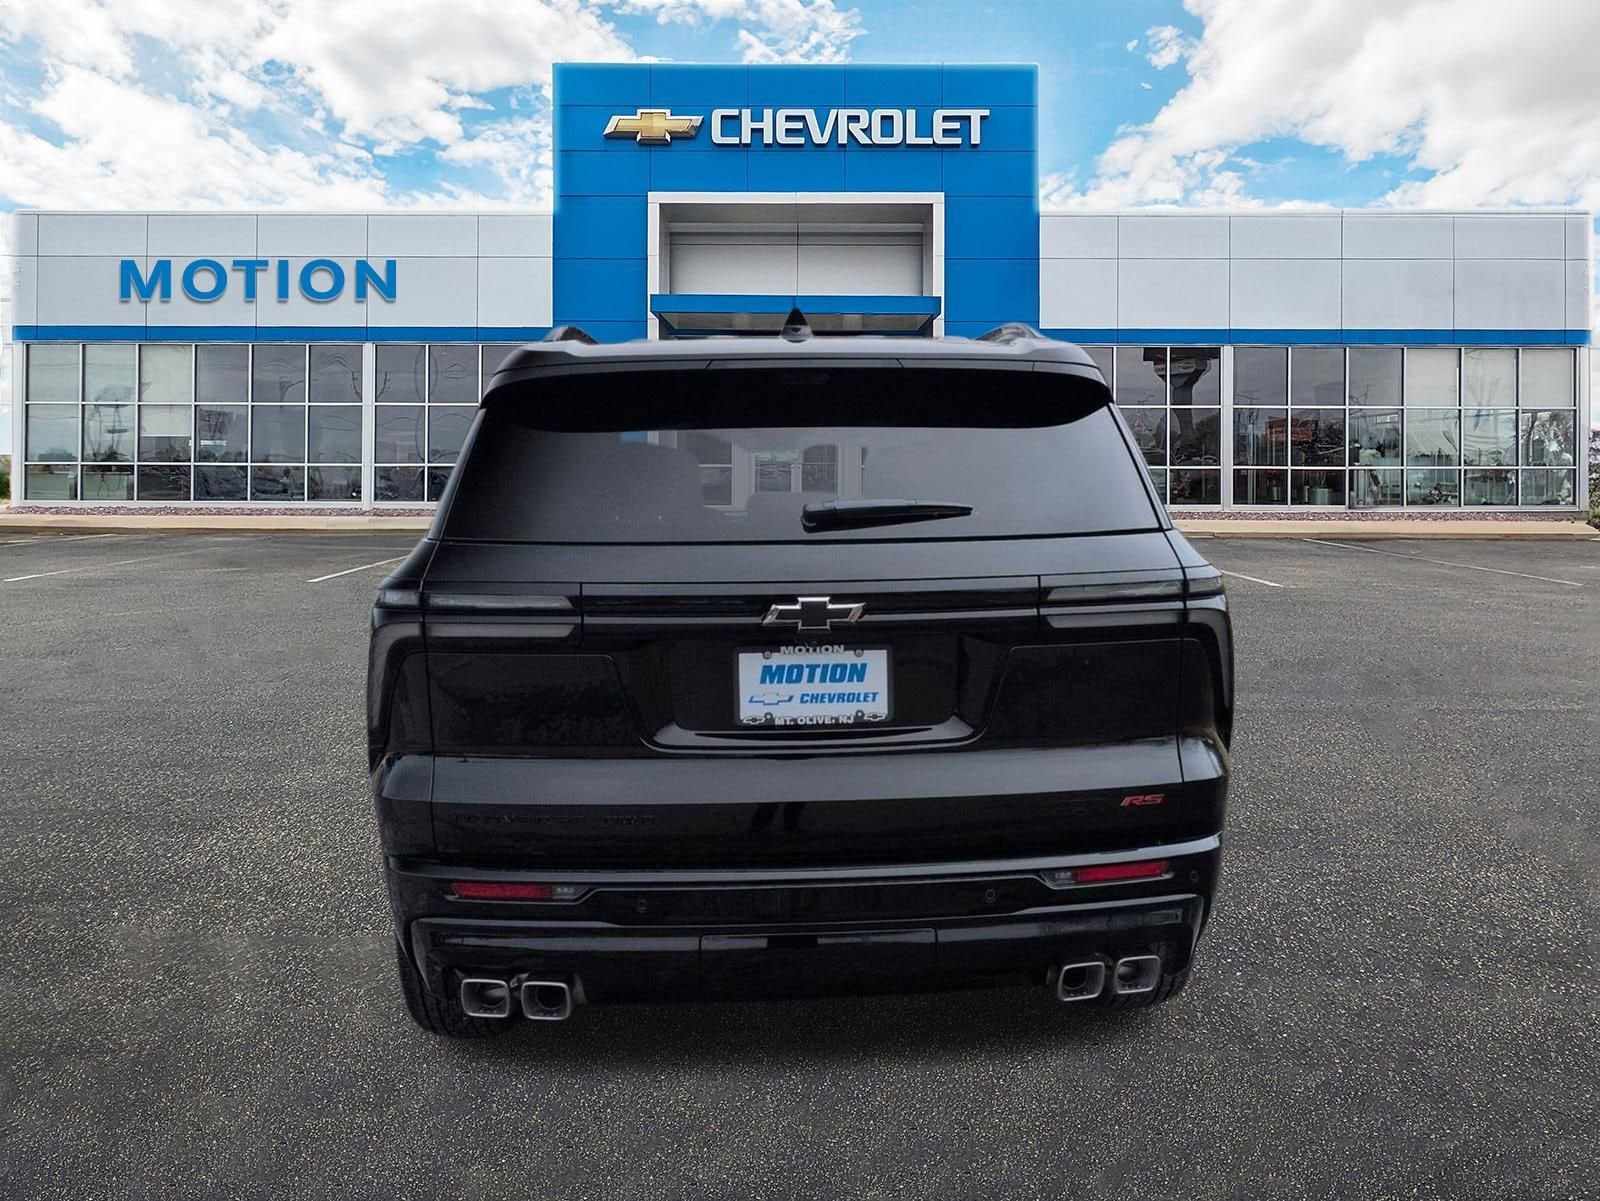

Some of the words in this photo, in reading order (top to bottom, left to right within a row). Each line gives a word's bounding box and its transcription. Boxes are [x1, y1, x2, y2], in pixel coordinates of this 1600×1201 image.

[711, 108, 990, 145] CHEVROLET
[119, 259, 397, 302] MOTION
[780, 645, 845, 656] MOTION
[760, 663, 867, 685] MOTION
[800, 692, 879, 704] CHEVROLET
[1120, 794, 1165, 806] RS
